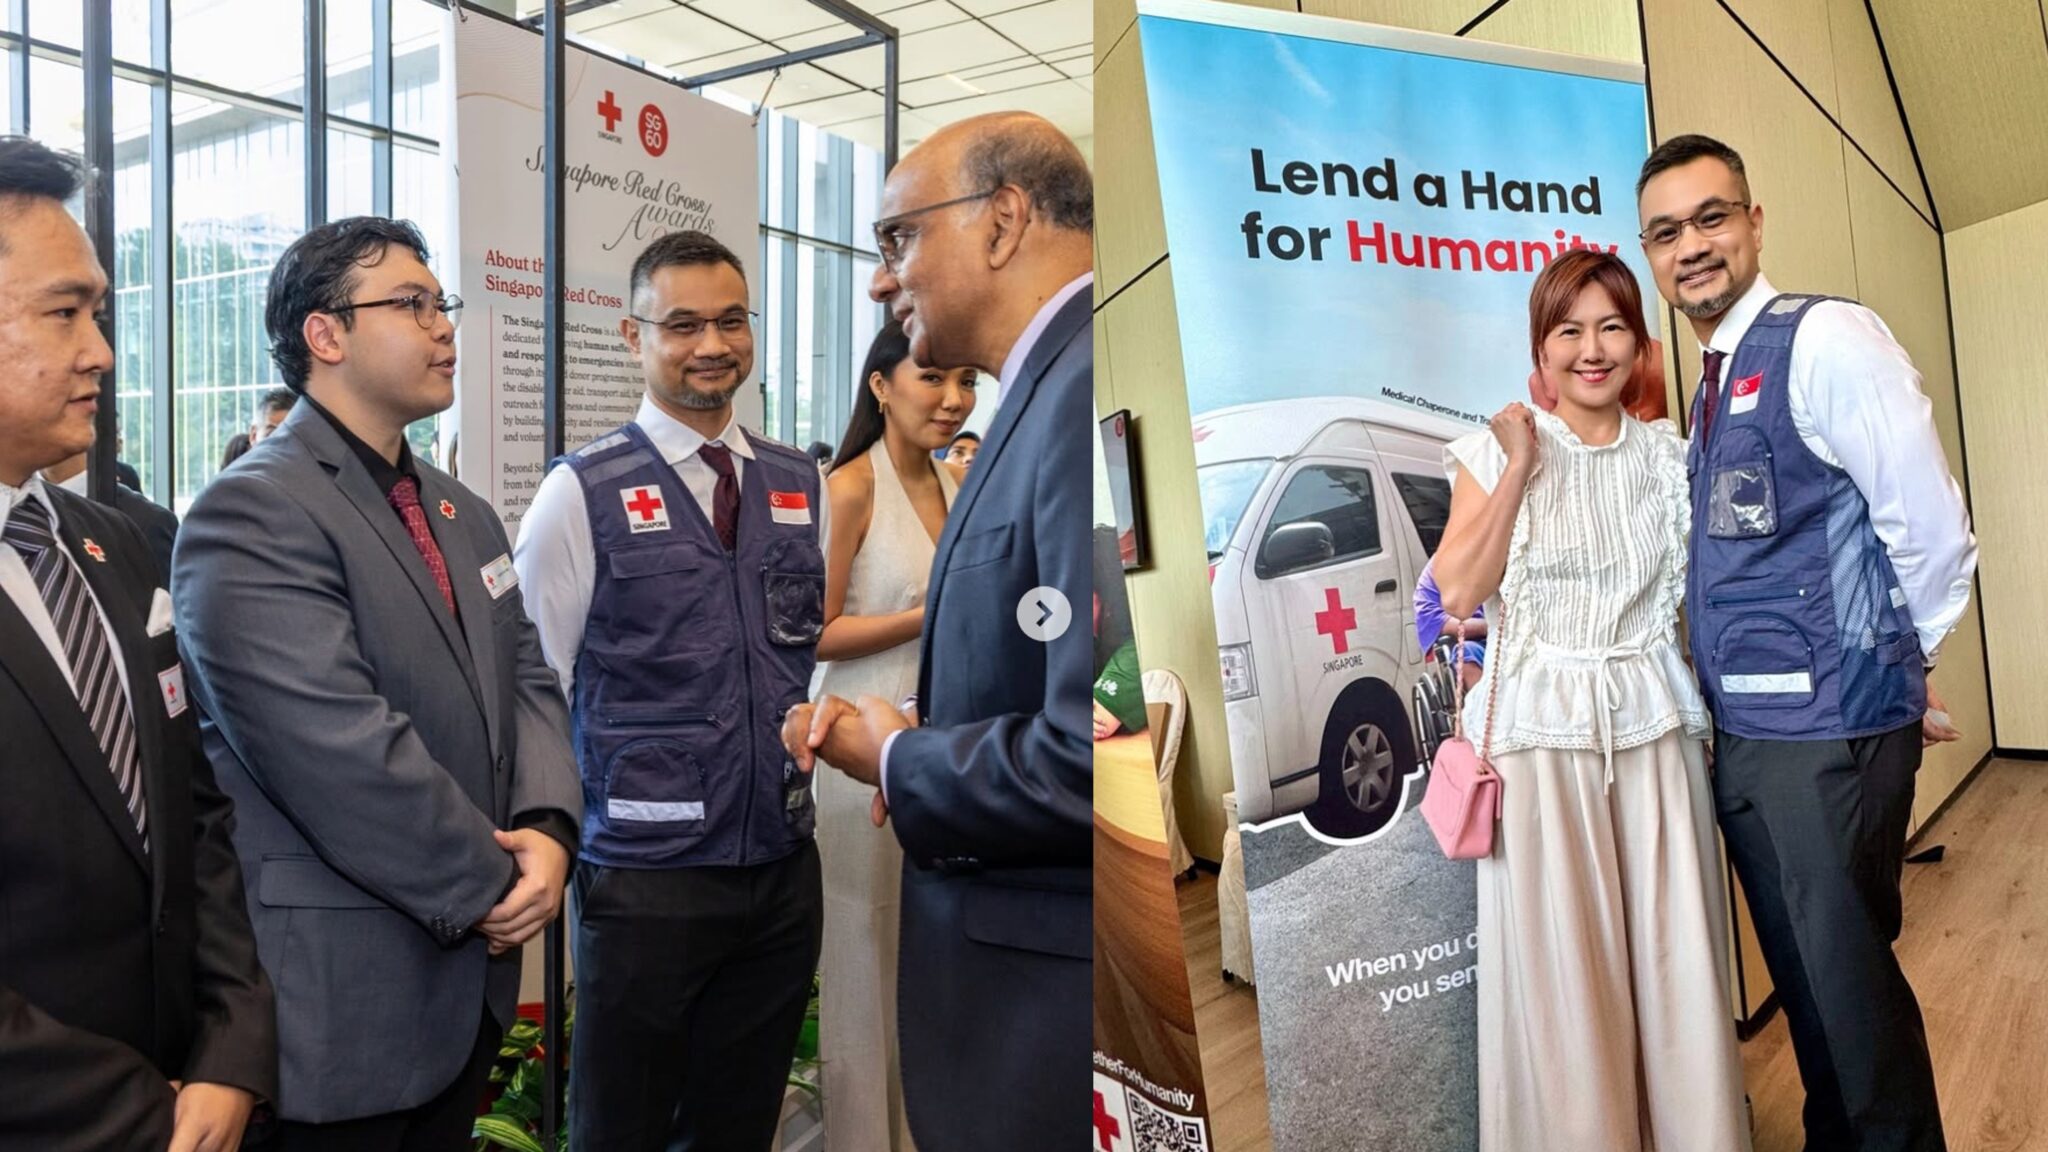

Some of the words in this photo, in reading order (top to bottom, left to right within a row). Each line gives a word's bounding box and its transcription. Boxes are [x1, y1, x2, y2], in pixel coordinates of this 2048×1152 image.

[645, 112, 662, 131] SG
[645, 129, 662, 149] 60
[623, 169, 664, 202] Red
[665, 181, 706, 213] Cross
[1250, 147, 1399, 202] Lend
[1413, 172, 1448, 208] a
[1461, 169, 1602, 216] Hand
[602, 203, 715, 251] Awards
[1240, 211, 1331, 261] for
[485, 249, 529, 272] About
[532, 257, 545, 273] th
[485, 273, 543, 299] Singapo
[587, 289, 622, 309] Cross
[502, 314, 519, 326] The
[521, 316, 545, 330] Singa
[581, 324, 602, 336] Cross
[503, 331, 541, 345] dedicated
[584, 340, 609, 351] human
[503, 350, 519, 359] and
[569, 355, 578, 364] to
[503, 365, 534, 378] through
[569, 369, 590, 380] donor
[503, 381, 516, 393] the
[503, 400, 539, 410] outreach
[584, 402, 597, 412] and
[1381, 386, 1415, 405] Medical
[1416, 396, 1460, 418] Chaperone
[1461, 411, 1478, 423] and
[503, 415, 513, 428] by
[579, 417, 592, 428] and
[503, 431, 519, 442] and
[503, 462, 533, 475] Beyond
[503, 479, 522, 490] from
[524, 479, 537, 489] the
[503, 495, 519, 506] and
[632, 520, 667, 530] SINGAPORE
[1322, 654, 1364, 674] SINGAPORE
[1325, 952, 1407, 987] When
[1412, 937, 1460, 972] you
[1379, 979, 1430, 1012] you
[1435, 964, 1478, 993] sen
